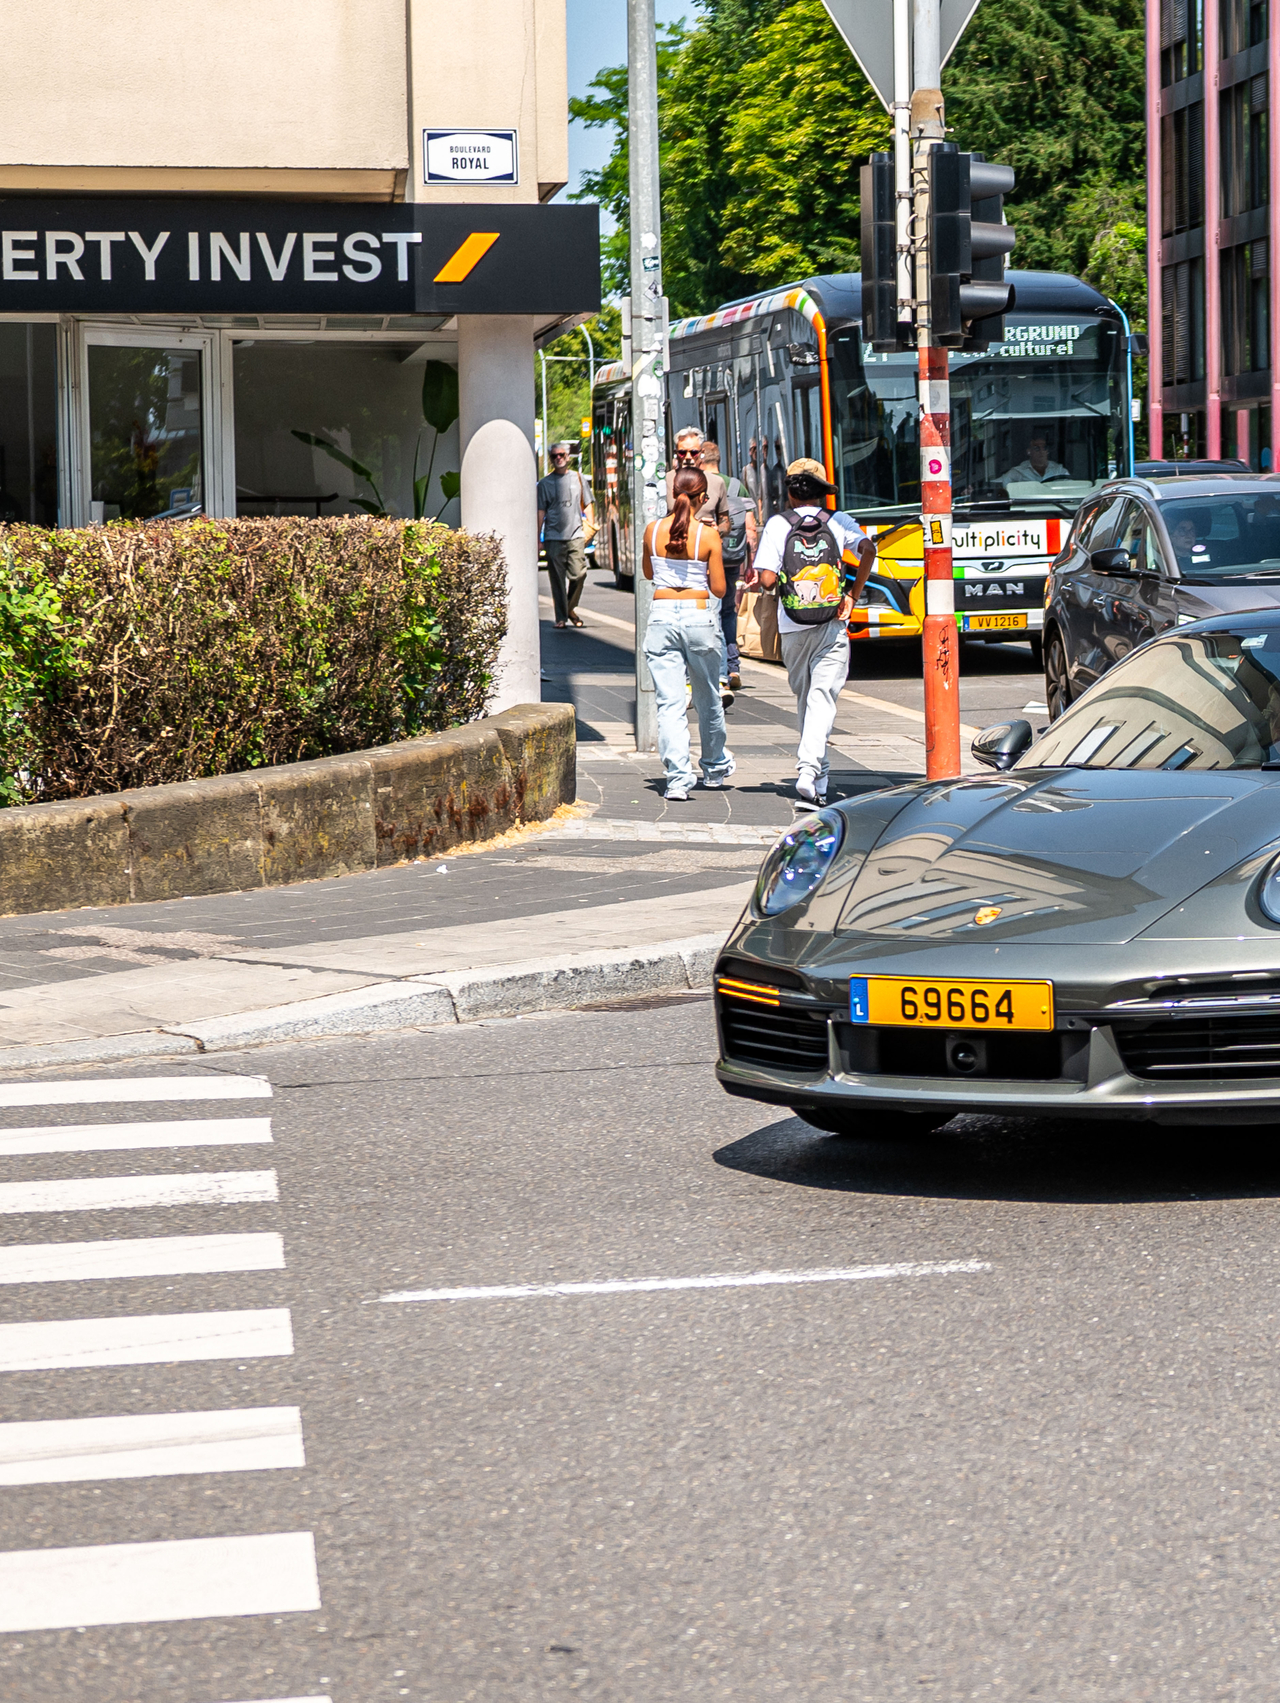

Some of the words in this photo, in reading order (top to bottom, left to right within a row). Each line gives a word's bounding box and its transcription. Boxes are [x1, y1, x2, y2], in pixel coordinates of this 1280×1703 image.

[449, 145, 492, 154] BOULEVARD
[452, 157, 490, 170] ROYAL
[1, 230, 171, 282] ERTY
[188, 231, 423, 283] INVEST
[1004, 325, 1080, 342] RGRUND
[1000, 341, 1074, 358] culturel
[964, 582, 1025, 598] MAN
[977, 617, 992, 628] VV
[994, 616, 1019, 628] 1216
[900, 986, 1016, 1025] 69664
